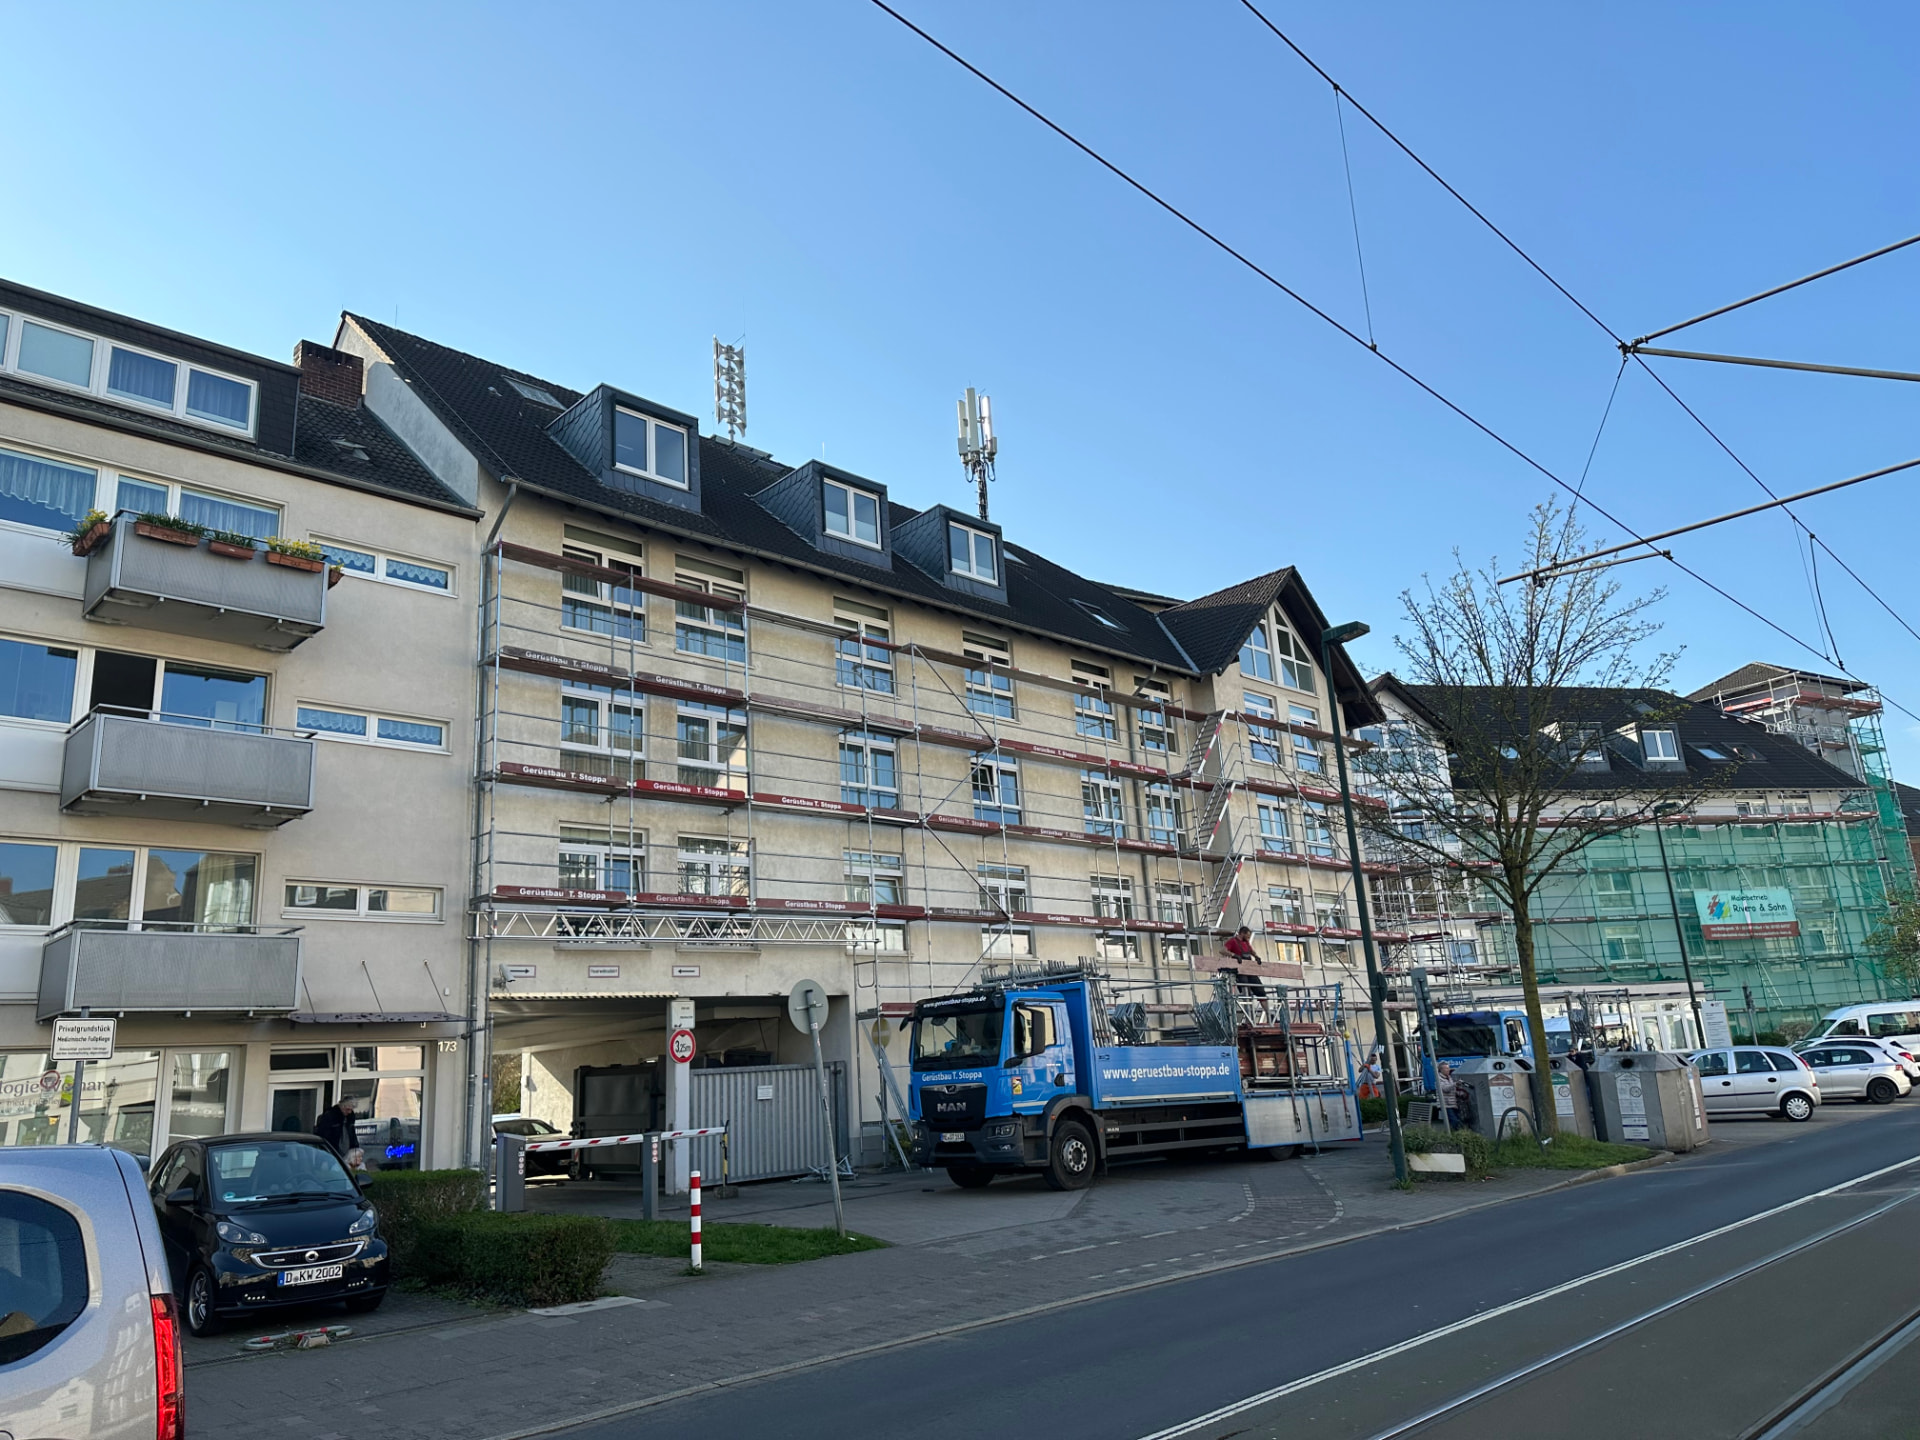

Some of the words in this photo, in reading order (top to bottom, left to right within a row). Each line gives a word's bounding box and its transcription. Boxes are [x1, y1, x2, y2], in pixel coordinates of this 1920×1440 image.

[525, 650, 568, 665] Gerüstbau
[581, 662, 608, 673] Stoppa
[656, 676, 692, 689] Gerüstbau
[704, 684, 727, 695] Stoppa
[522, 766, 566, 778] Gerüstbau
[579, 773, 607, 783] Stoppa
[654, 782, 692, 793] Gerüstbau
[704, 788, 728, 796] Stoppa
[782, 796, 813, 806] Gerüstbau
[820, 802, 841, 810] Stoppa
[520, 888, 564, 897] Gerüstbau
[578, 891, 606, 900] Stoppa
[1733, 904, 1756, 912] Rivero
[1768, 903, 1787, 911] Sohn
[438, 1041, 457, 1052] 173
[922, 1072, 952, 1082] Gerüstbau
[953, 1072, 958, 1080] T.
[959, 1071, 982, 1081] Stoppa
[1103, 1063, 1230, 1082] www.geruestbau-stoppa.de
[937, 1102, 966, 1112] MAN
[315, 1266, 342, 1280] 2002
